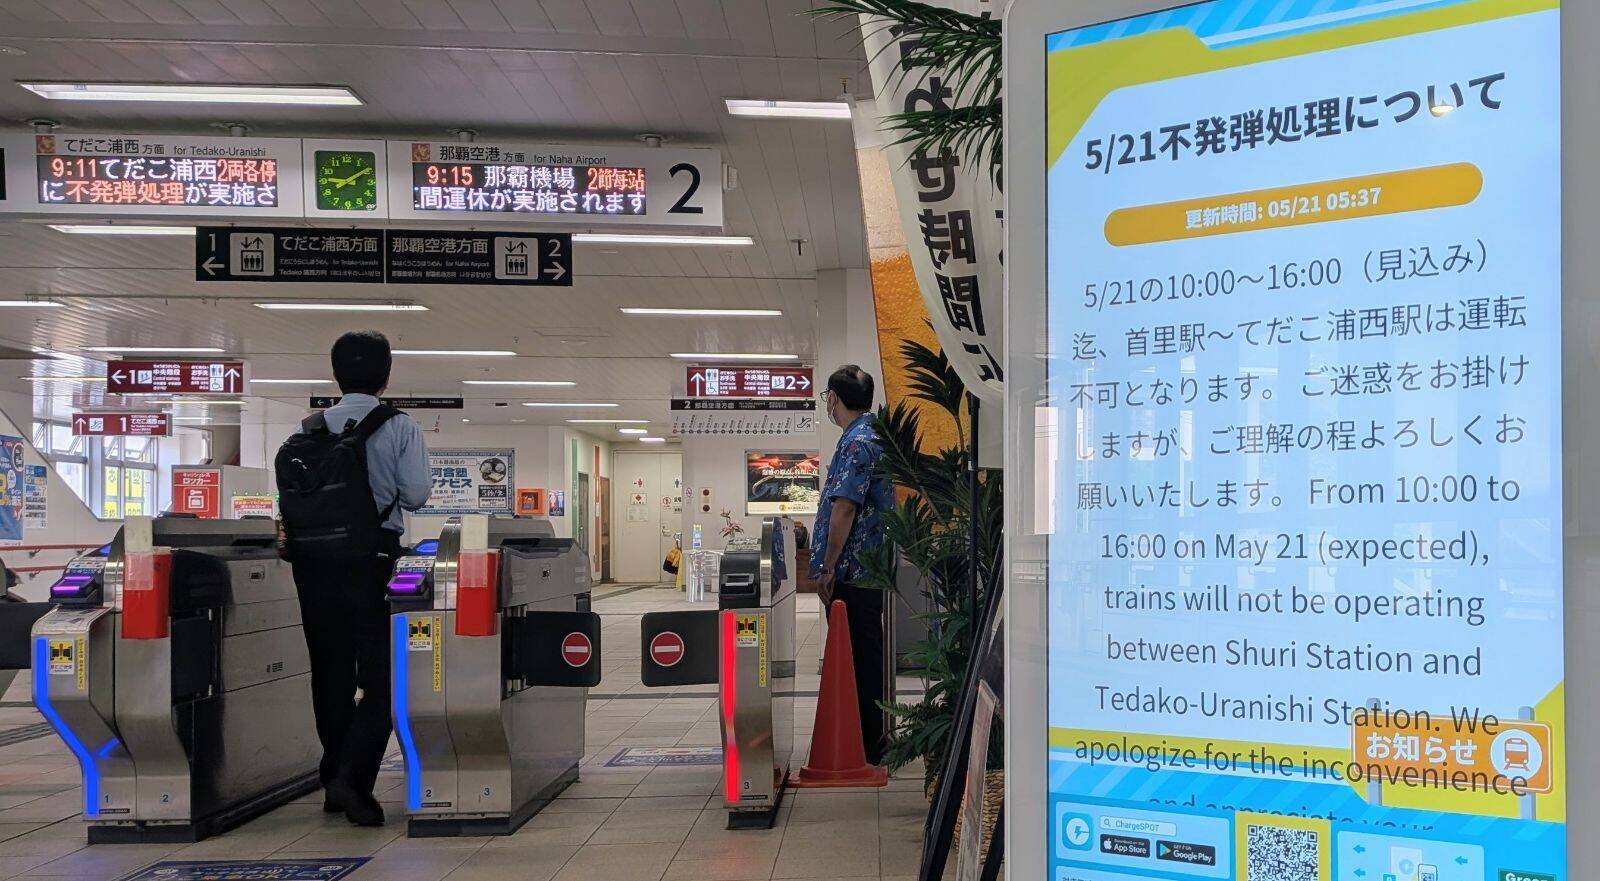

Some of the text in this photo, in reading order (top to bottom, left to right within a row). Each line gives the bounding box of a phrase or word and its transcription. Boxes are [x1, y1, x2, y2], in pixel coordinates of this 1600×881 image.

[1085, 72, 1506, 174] 5/21不発弾処理について
[64, 138, 266, 156] てだこ浦西 方面 for Tedako-Uranishi
[440, 146, 607, 166] 那覇空港 方面 for Naha Airport
[52, 158, 276, 183] 9:11 てだこ浦西 2両各停
[427, 166, 473, 185] 9:15
[42, 180, 276, 206] に不発弾処理が実施さ
[667, 163, 704, 214] 2
[414, 186, 646, 213] 間運休が実施されます
[1185, 187, 1382, 231] 更新時間: 05/21 05:37
[208, 233, 216, 252] 1
[279, 236, 378, 253] てだこ浦西方面
[392, 237, 489, 254] 那覇空港方面
[548, 239, 562, 257] 2
[130, 370, 136, 384] 1
[785, 375, 796, 390] 2
[684, 401, 691, 409] 2
[120, 417, 127, 432] 1
[1077, 411, 1528, 461] しますが、ご理解の程よろしくお
[183, 478, 211, 486] ロッカー
[1077, 474, 1521, 511] 願いいたします。 From 10:00 to
[1101, 529, 1490, 567] 16:00 on May 21 (expected),
[1104, 584, 1485, 626] trains will not be operating
[1107, 634, 1482, 677] between Shuri Station and
[1095, 685, 1500, 737] Tedako-Uranishi Station. We
[1366, 731, 1478, 767] お知らせ
[1075, 736, 1528, 797] apologize for the inconvenience
[425, 789, 432, 798] 2
[483, 788, 490, 796] 3
[744, 782, 750, 790] 3
[104, 794, 110, 803] 1
[162, 794, 169, 803] 2
[1115, 820, 1160, 832] ChargeSPOT
[1114, 844, 1147, 854] App Store
[1173, 850, 1212, 864] Google Play
